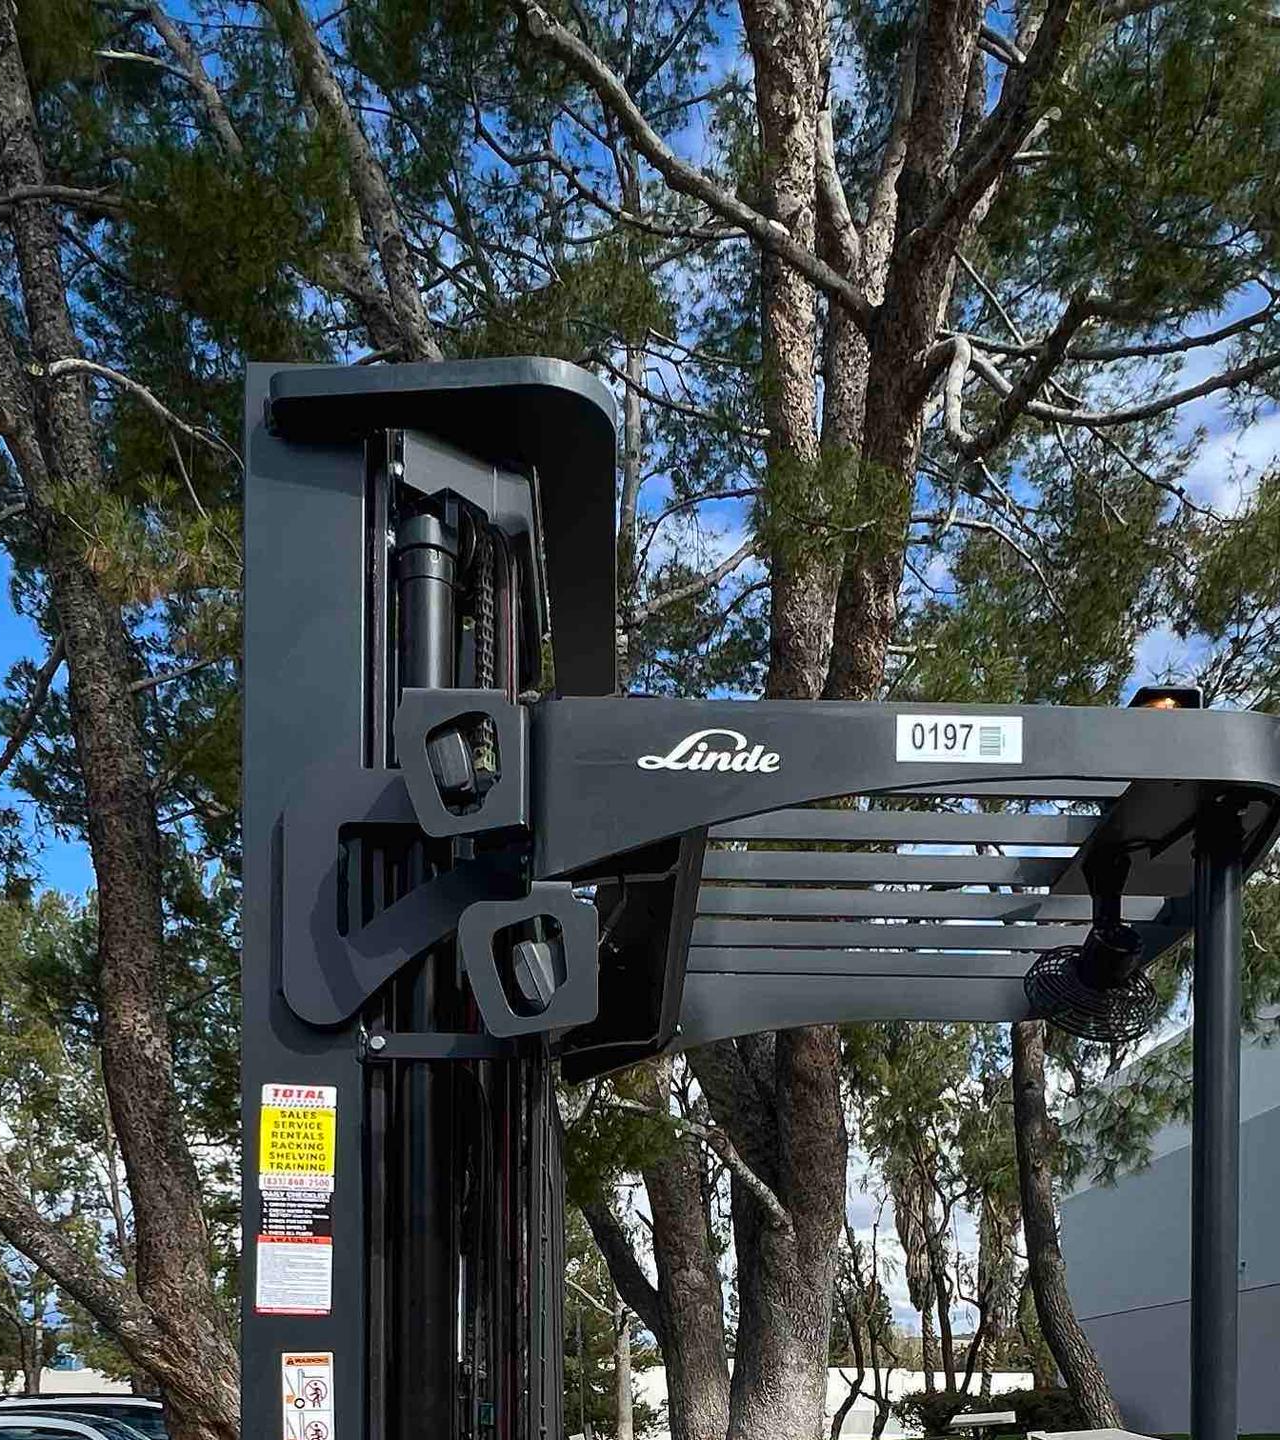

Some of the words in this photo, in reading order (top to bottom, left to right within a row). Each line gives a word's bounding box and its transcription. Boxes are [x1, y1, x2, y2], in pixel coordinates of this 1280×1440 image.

[911, 722, 974, 751] 0197
[637, 728, 780, 773] Linde
[272, 1088, 325, 1099] TOTAL
[280, 1110, 317, 1119] SALES
[274, 1120, 323, 1130] SERVICE
[271, 1131, 324, 1140] RENTALS
[271, 1141, 324, 1151] RACKING
[269, 1151, 326, 1161] SHELVING
[269, 1162, 326, 1171] TRAINING
